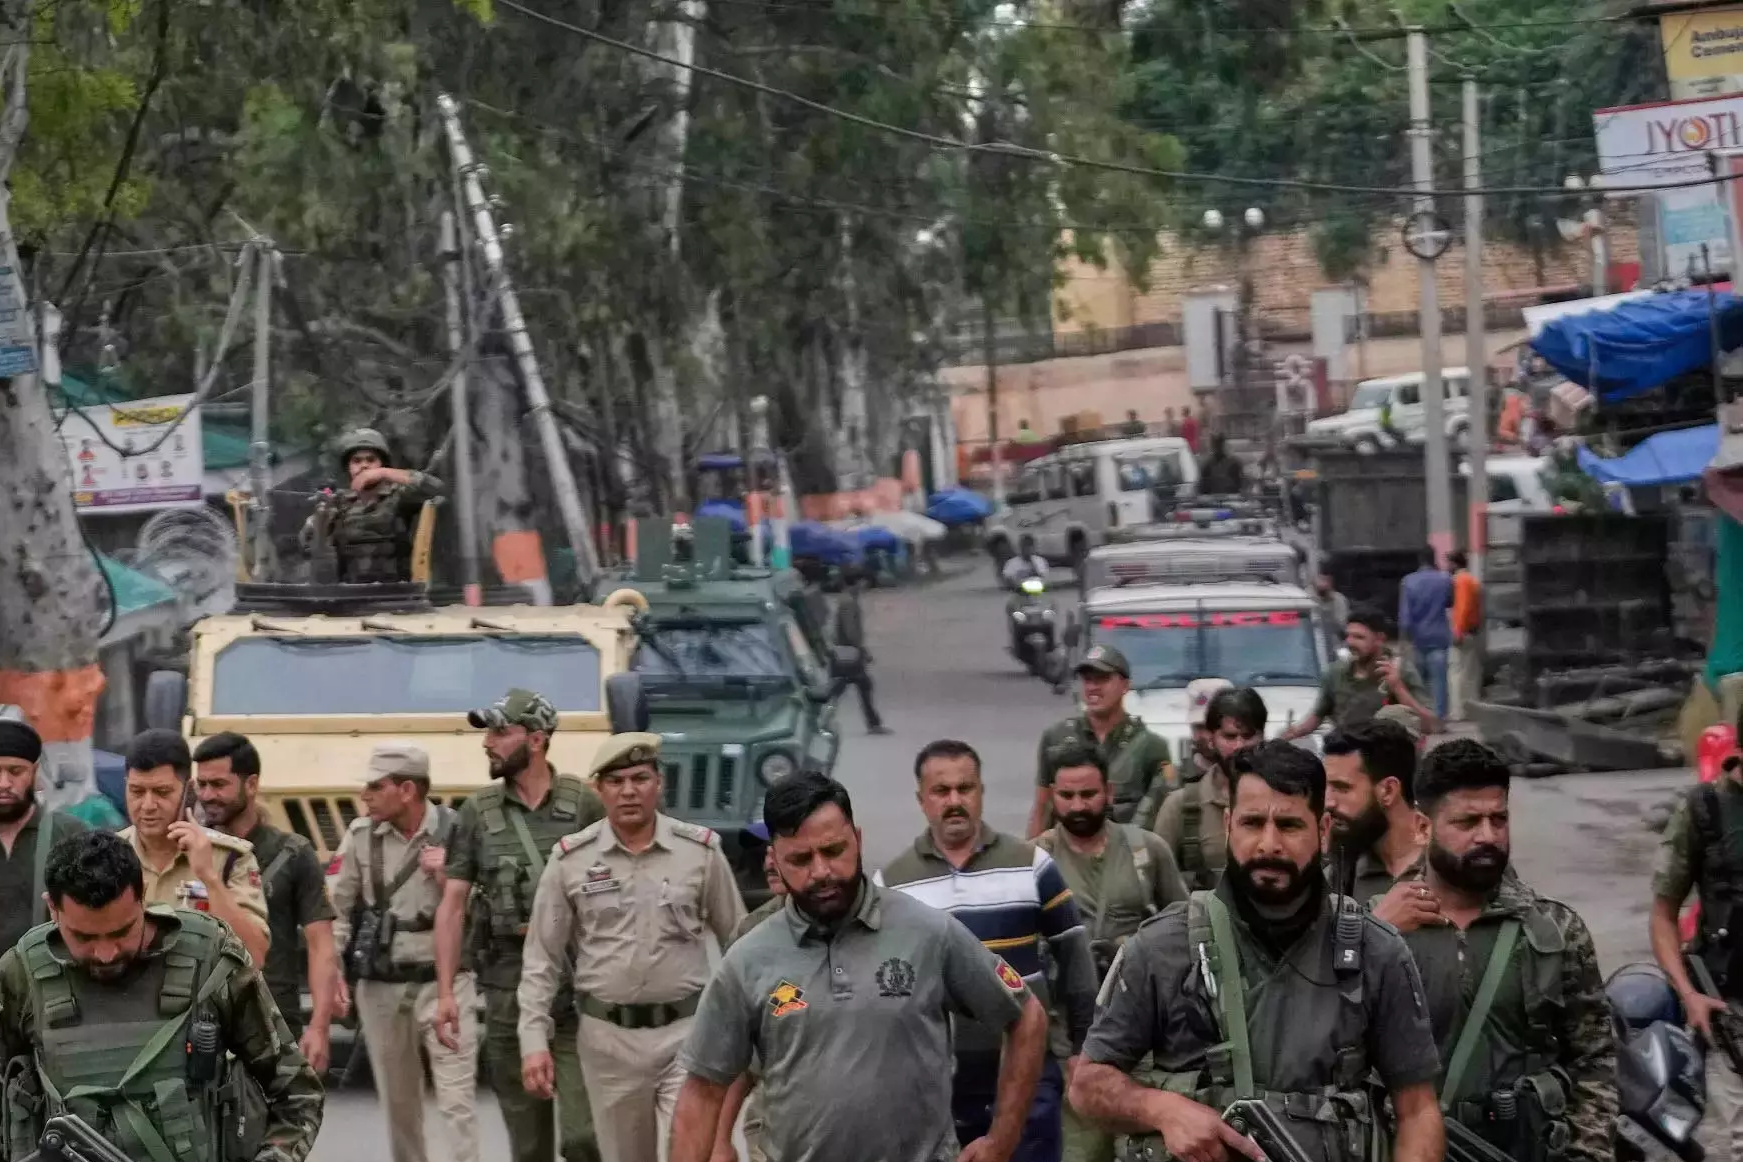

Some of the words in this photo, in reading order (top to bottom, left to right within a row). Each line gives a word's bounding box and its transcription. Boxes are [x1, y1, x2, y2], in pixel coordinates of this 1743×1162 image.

[1690, 25, 1743, 42] Ambuj
[1100, 610, 1301, 629] POLICE
[1343, 949, 1355, 962] 5
